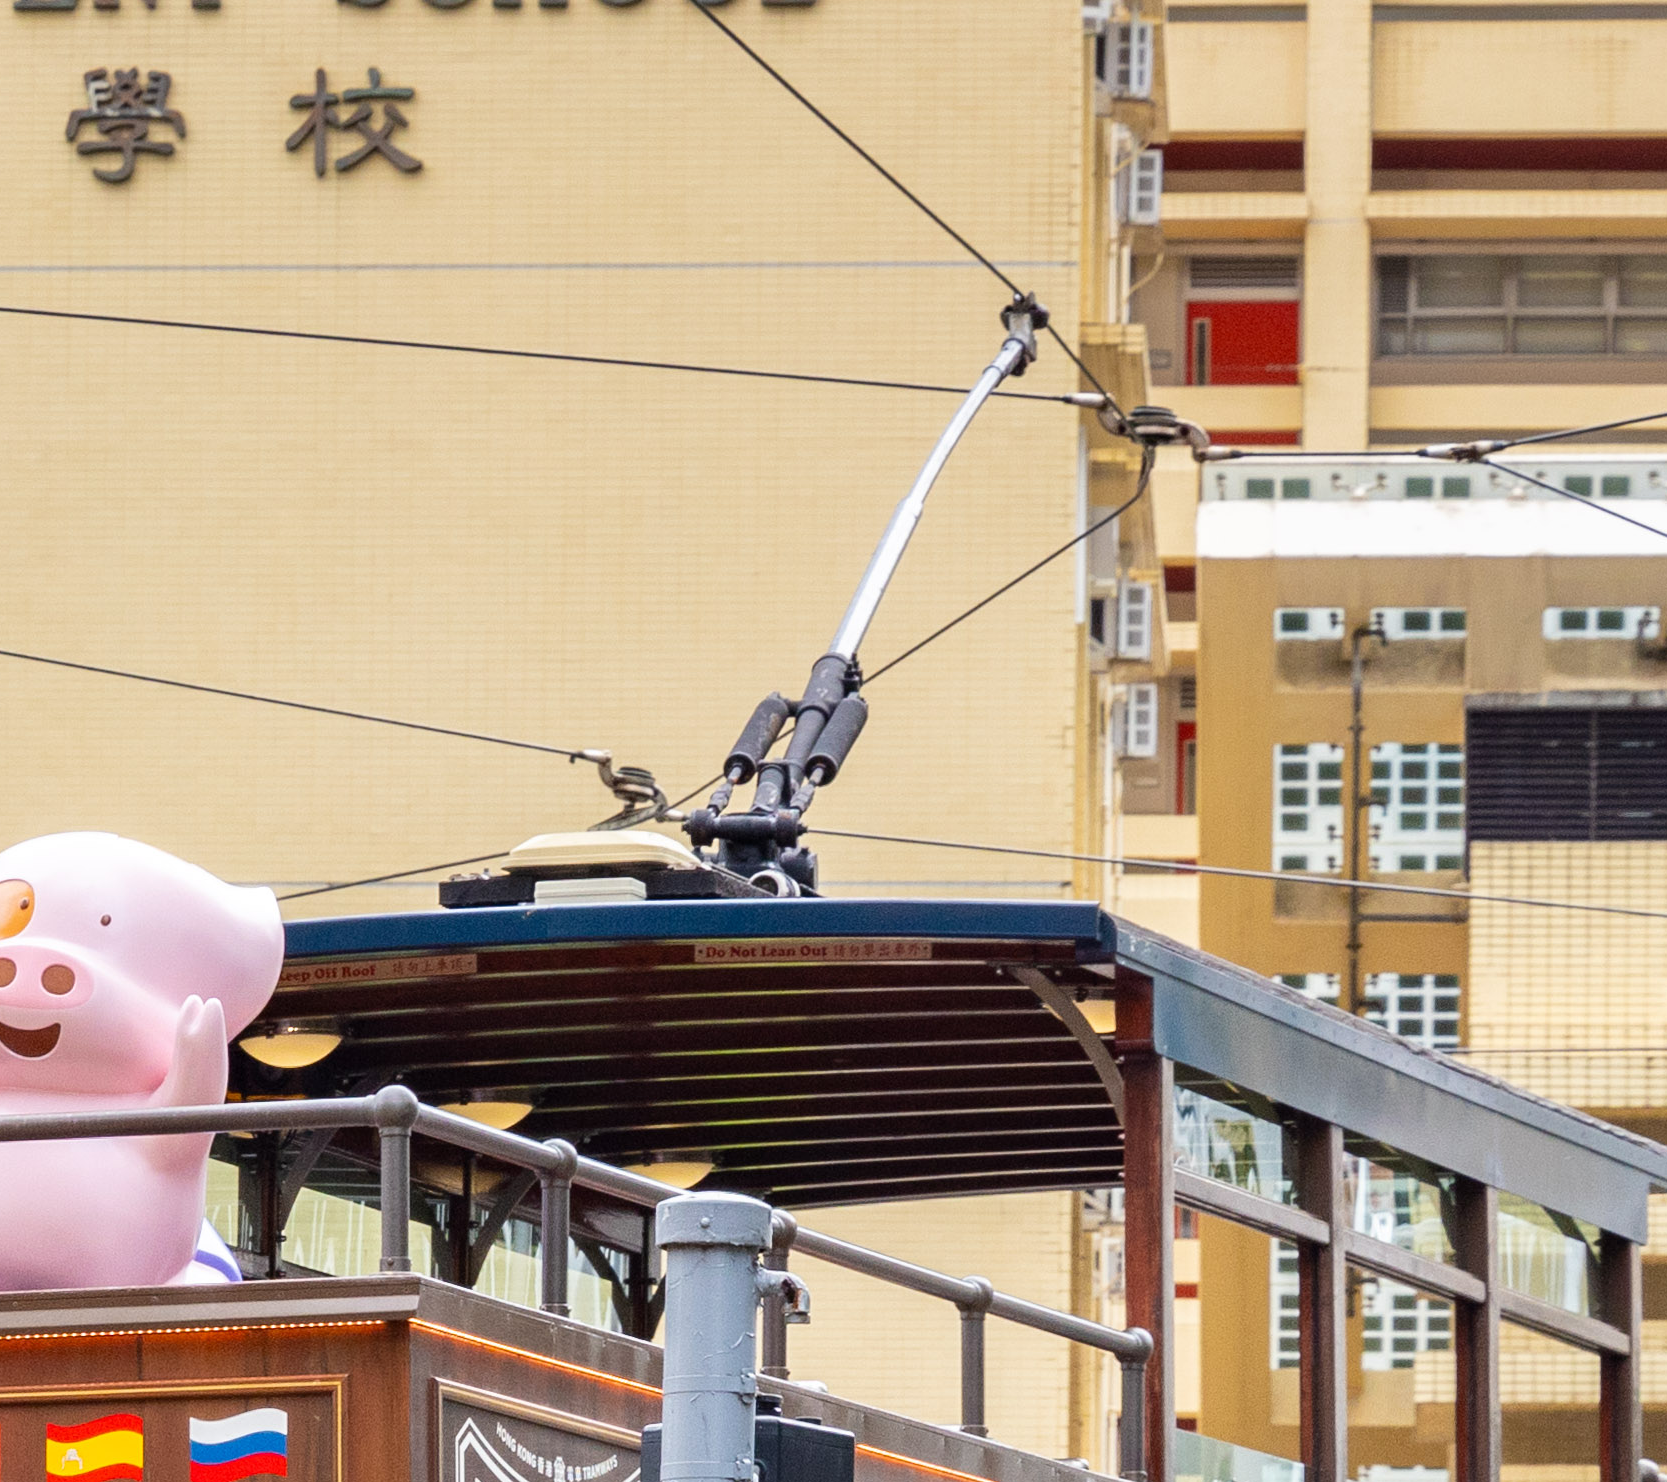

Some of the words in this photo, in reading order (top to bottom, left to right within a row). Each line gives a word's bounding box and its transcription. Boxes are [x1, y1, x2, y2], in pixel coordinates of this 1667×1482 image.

[705, 946, 725, 958] Do
[729, 946, 756, 958] Not
[761, 945, 796, 957] Lean
[800, 944, 827, 957] Out
[315, 967, 338, 979] Off
[341, 965, 376, 978] Roof
[496, 1421, 516, 1452] HONG
[517, 1443, 537, 1468] KONG
[582, 1454, 618, 1480] TRAMWAYS
